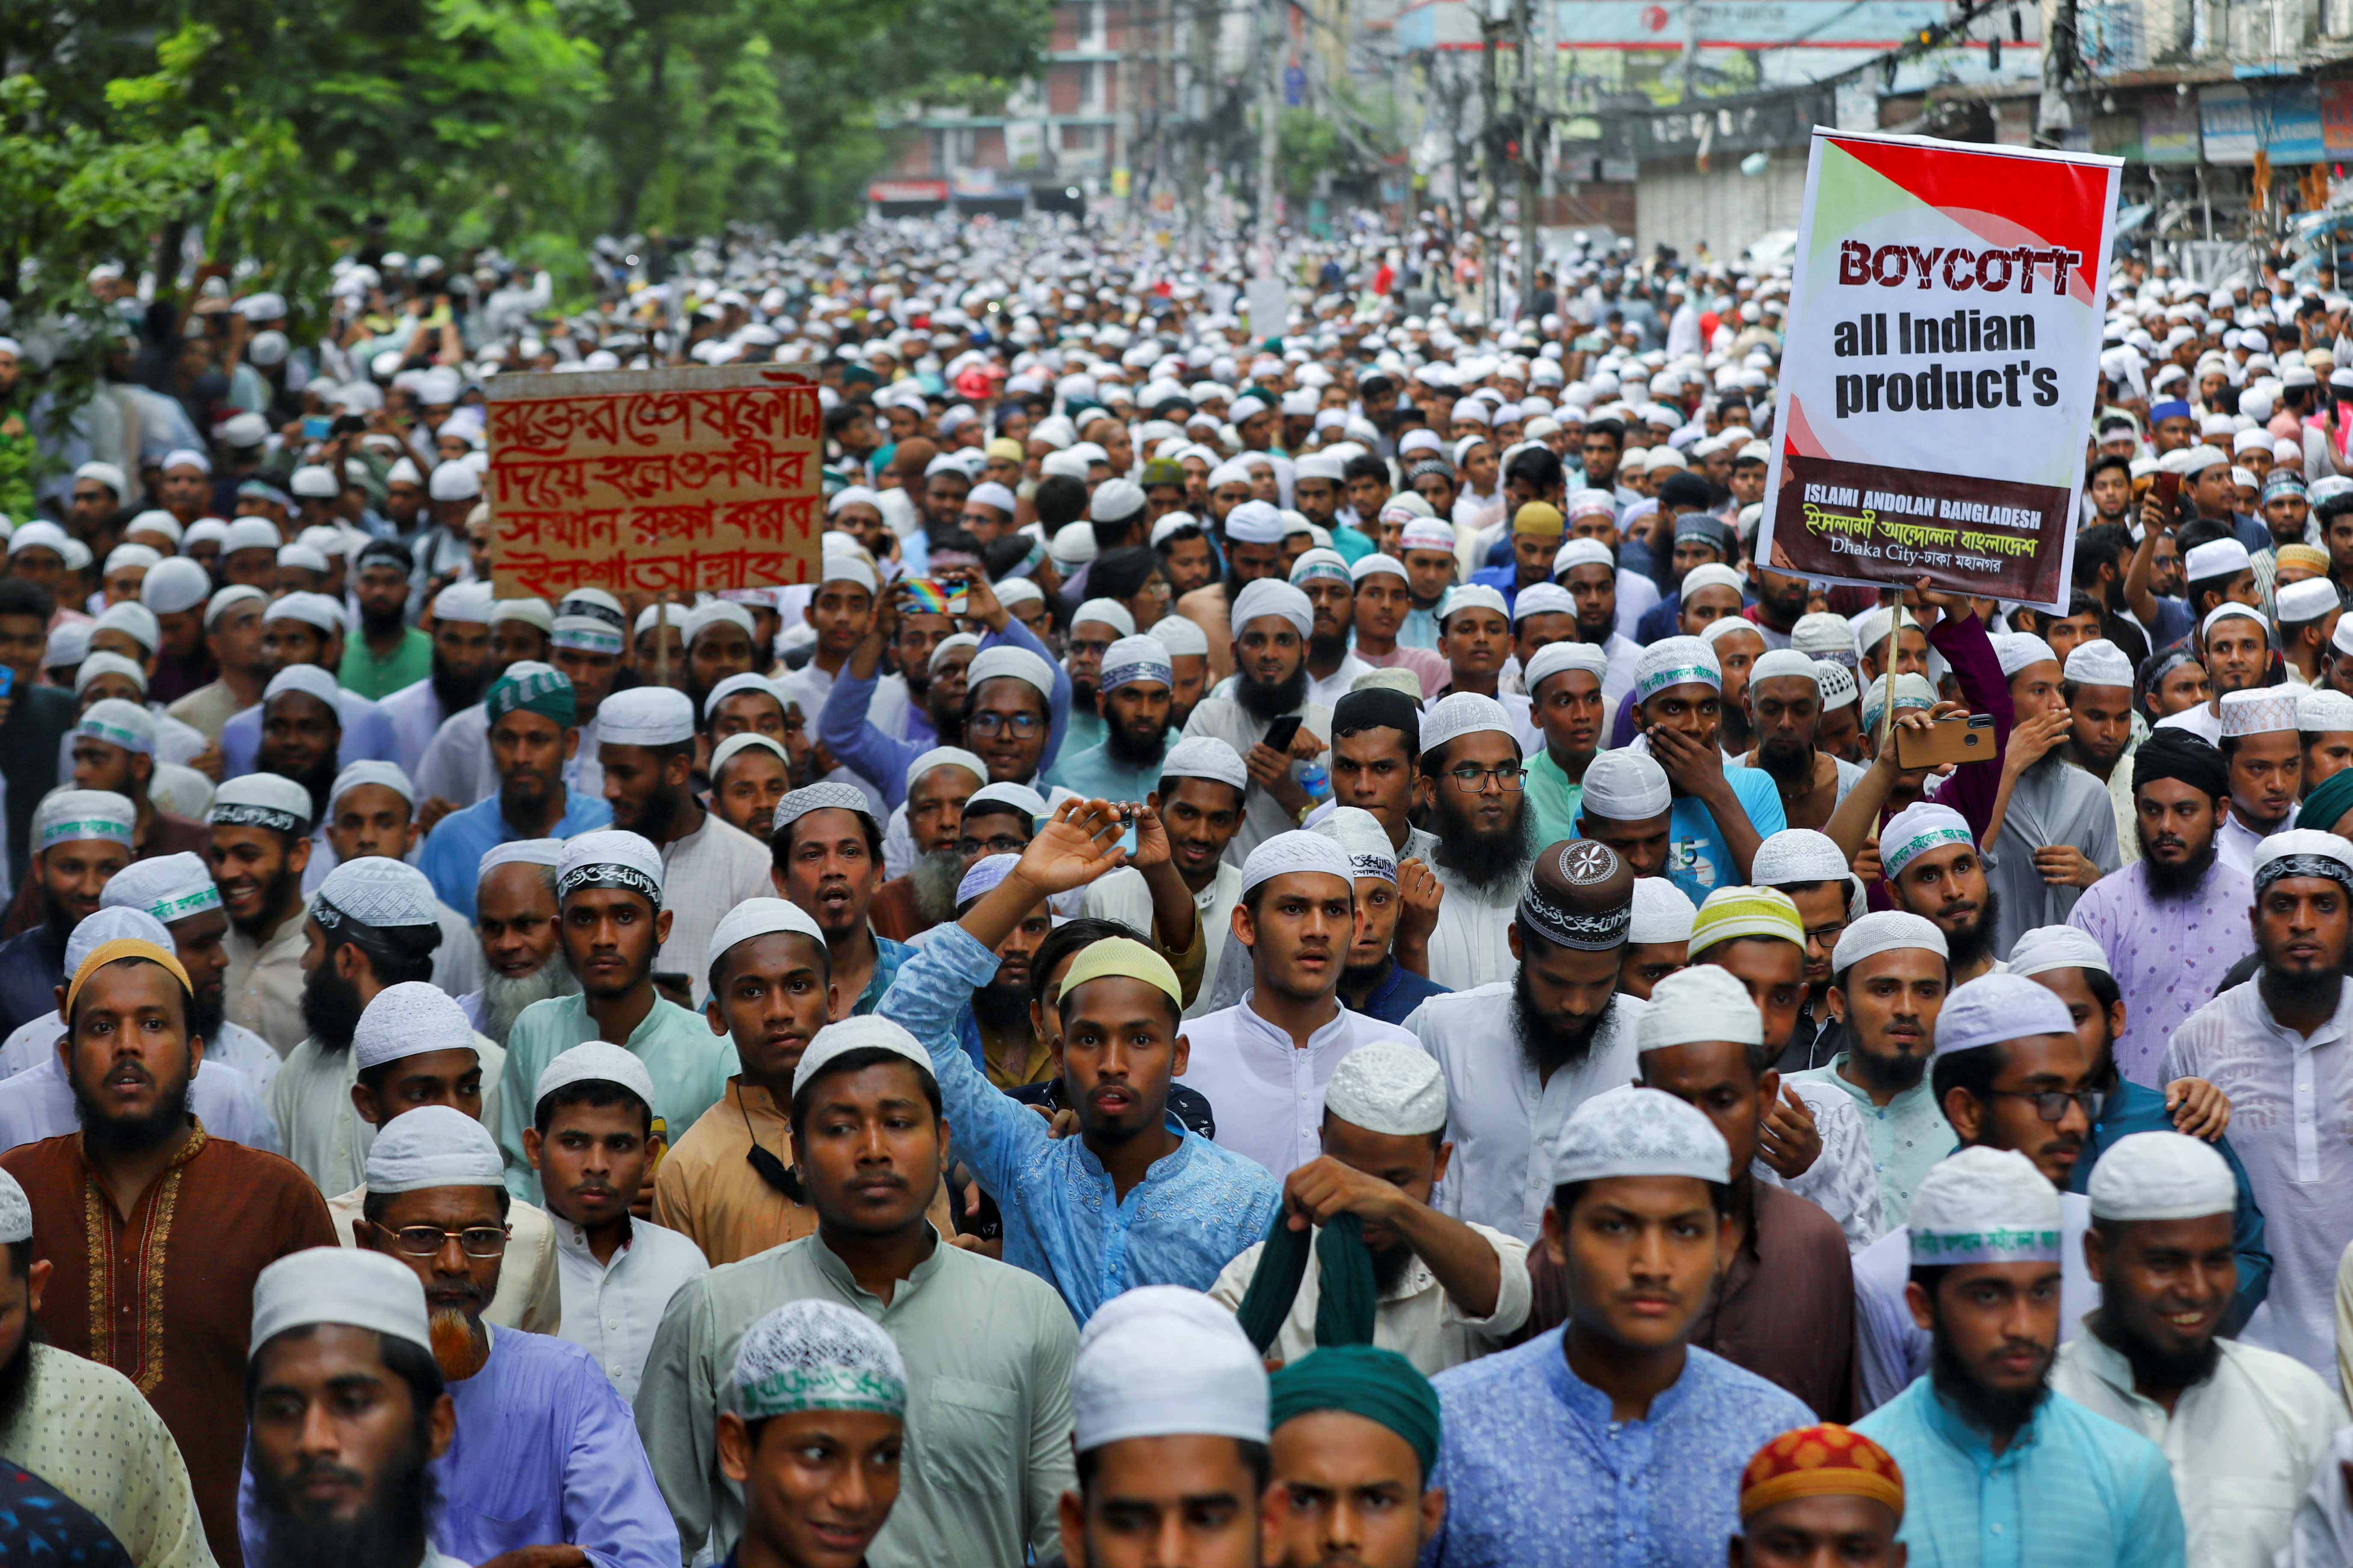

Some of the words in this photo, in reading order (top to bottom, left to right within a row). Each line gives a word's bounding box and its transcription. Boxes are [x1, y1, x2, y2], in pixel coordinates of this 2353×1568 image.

[1840, 240, 2079, 295] BOYCOTT
[1834, 313, 1887, 357] all
[1899, 309, 2035, 354] Indian
[1836, 360, 2058, 418] product's
[1802, 503, 1876, 539] ইসলামী
[1876, 521, 1958, 548] আন্দোলন
[1961, 531, 2039, 558] বাংলাদেশ
[1804, 483, 1859, 508] ISLAMI
[1862, 490, 1935, 517] ANDOLAN
[1939, 499, 2042, 530] BANGLADESH
[1830, 537, 1881, 558] Dhaka
[1955, 555, 2003, 574] মহানগর
[1665, 667, 1691, 681] অপমান
